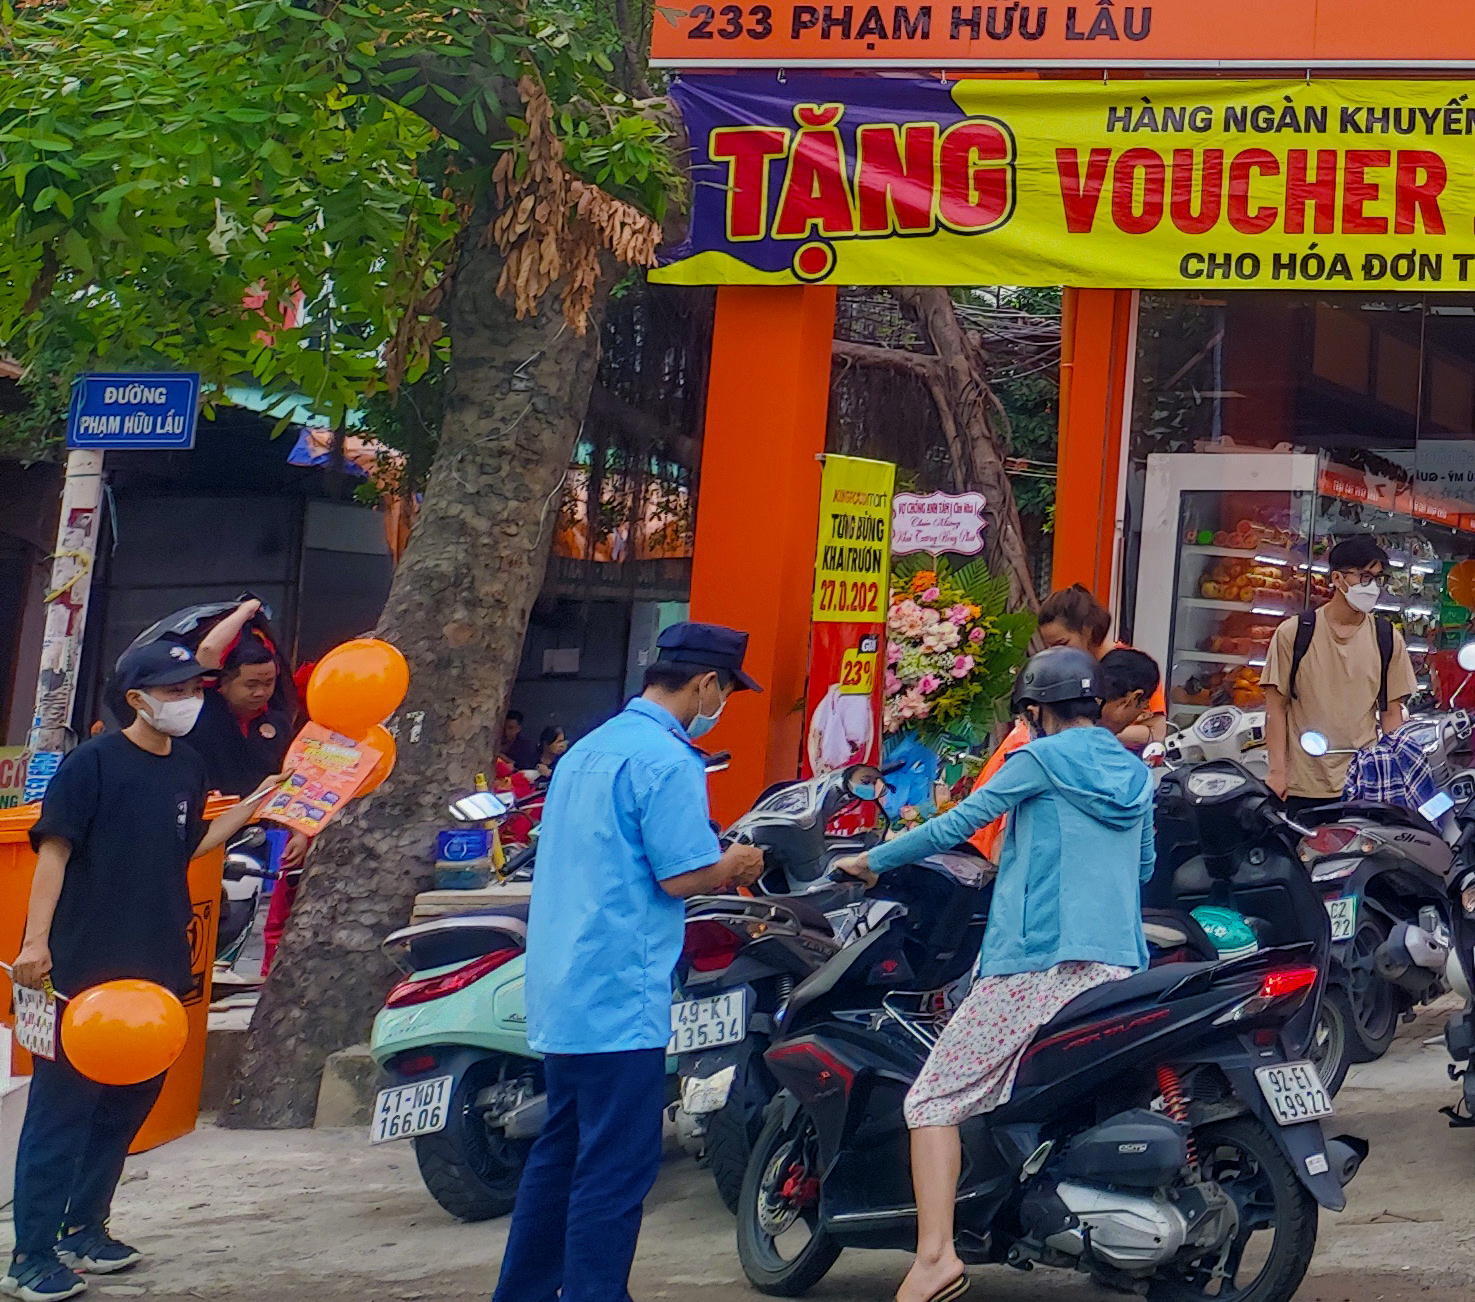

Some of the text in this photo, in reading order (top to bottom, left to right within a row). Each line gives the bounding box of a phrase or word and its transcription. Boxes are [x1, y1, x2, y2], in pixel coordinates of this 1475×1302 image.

[687, 4, 773, 40] 233
[790, 4, 931, 50] PHẠM
[1106, 97, 1213, 135] HÀNG
[1223, 93, 1329, 135] NGÀN
[708, 105, 1016, 282] TẶNG
[1054, 146, 1448, 236] VOUCHER
[1179, 253, 1266, 282] CHO
[1272, 243, 1354, 283] HÓA
[1361, 250, 1446, 283] ĐƠN
[104, 383, 168, 404] ĐƯỜNG
[80, 411, 154, 438] PHẠM HỮU
[677, 995, 732, 1025] 49-K1
[671, 1016, 741, 1052] 135.34
[1268, 1067, 1312, 1093] 92-E1
[1274, 1089, 1331, 1119] 499.22
[379, 1105, 443, 1140] 166.06
